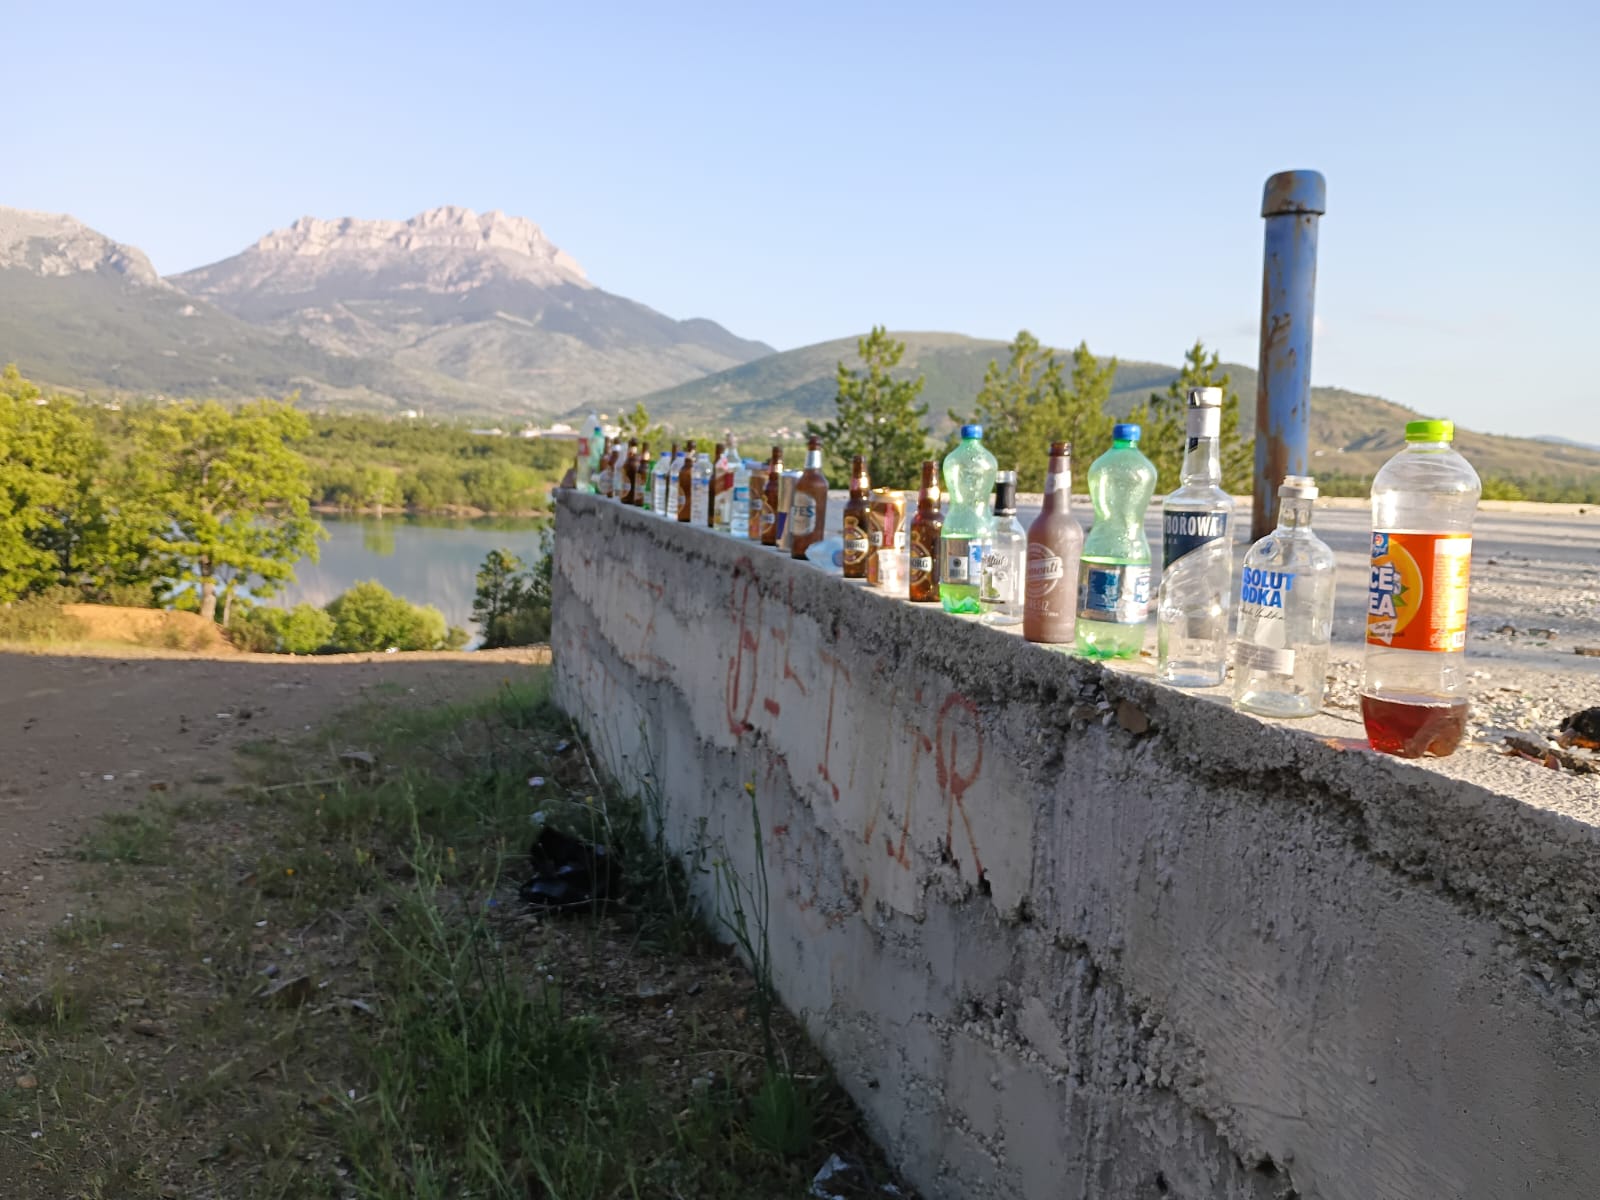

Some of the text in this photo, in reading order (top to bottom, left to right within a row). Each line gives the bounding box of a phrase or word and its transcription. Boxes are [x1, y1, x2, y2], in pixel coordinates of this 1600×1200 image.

[1370, 566, 1394, 590] CE
[1242, 584, 1282, 609] ODKA
[1369, 592, 1396, 618] EA
